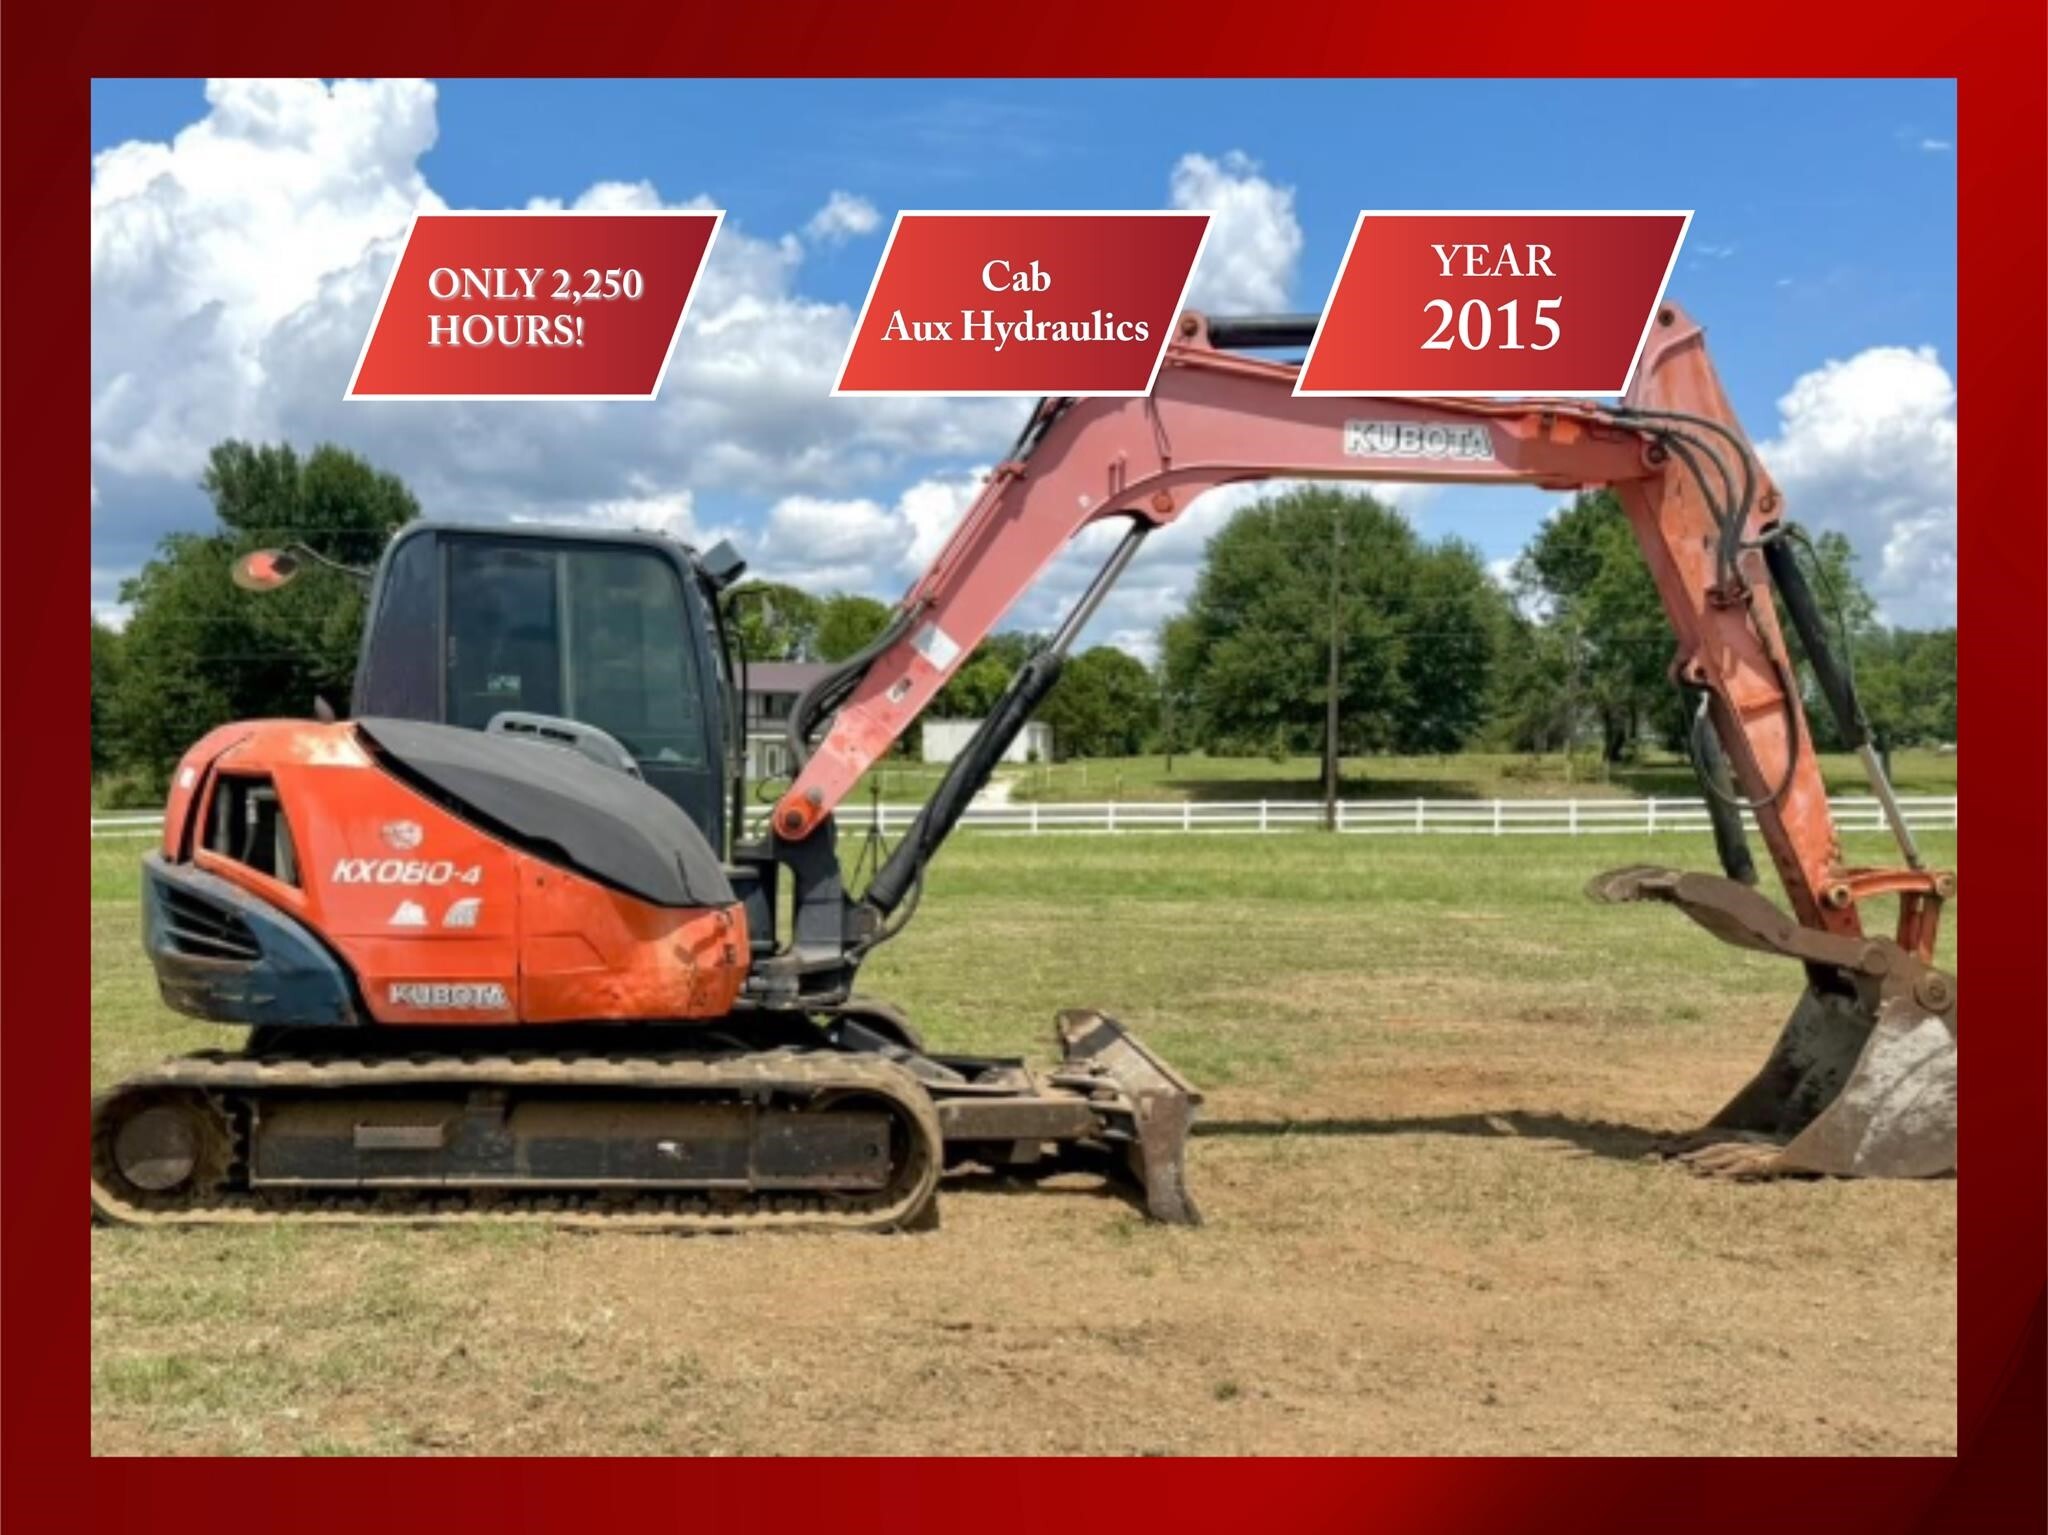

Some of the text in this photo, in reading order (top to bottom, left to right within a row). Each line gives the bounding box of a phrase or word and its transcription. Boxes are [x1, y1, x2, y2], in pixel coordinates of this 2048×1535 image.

[1344, 421, 1493, 460] KUBOTA
[331, 858, 482, 886] KX080-4
[389, 982, 508, 1010] KUBOTA
